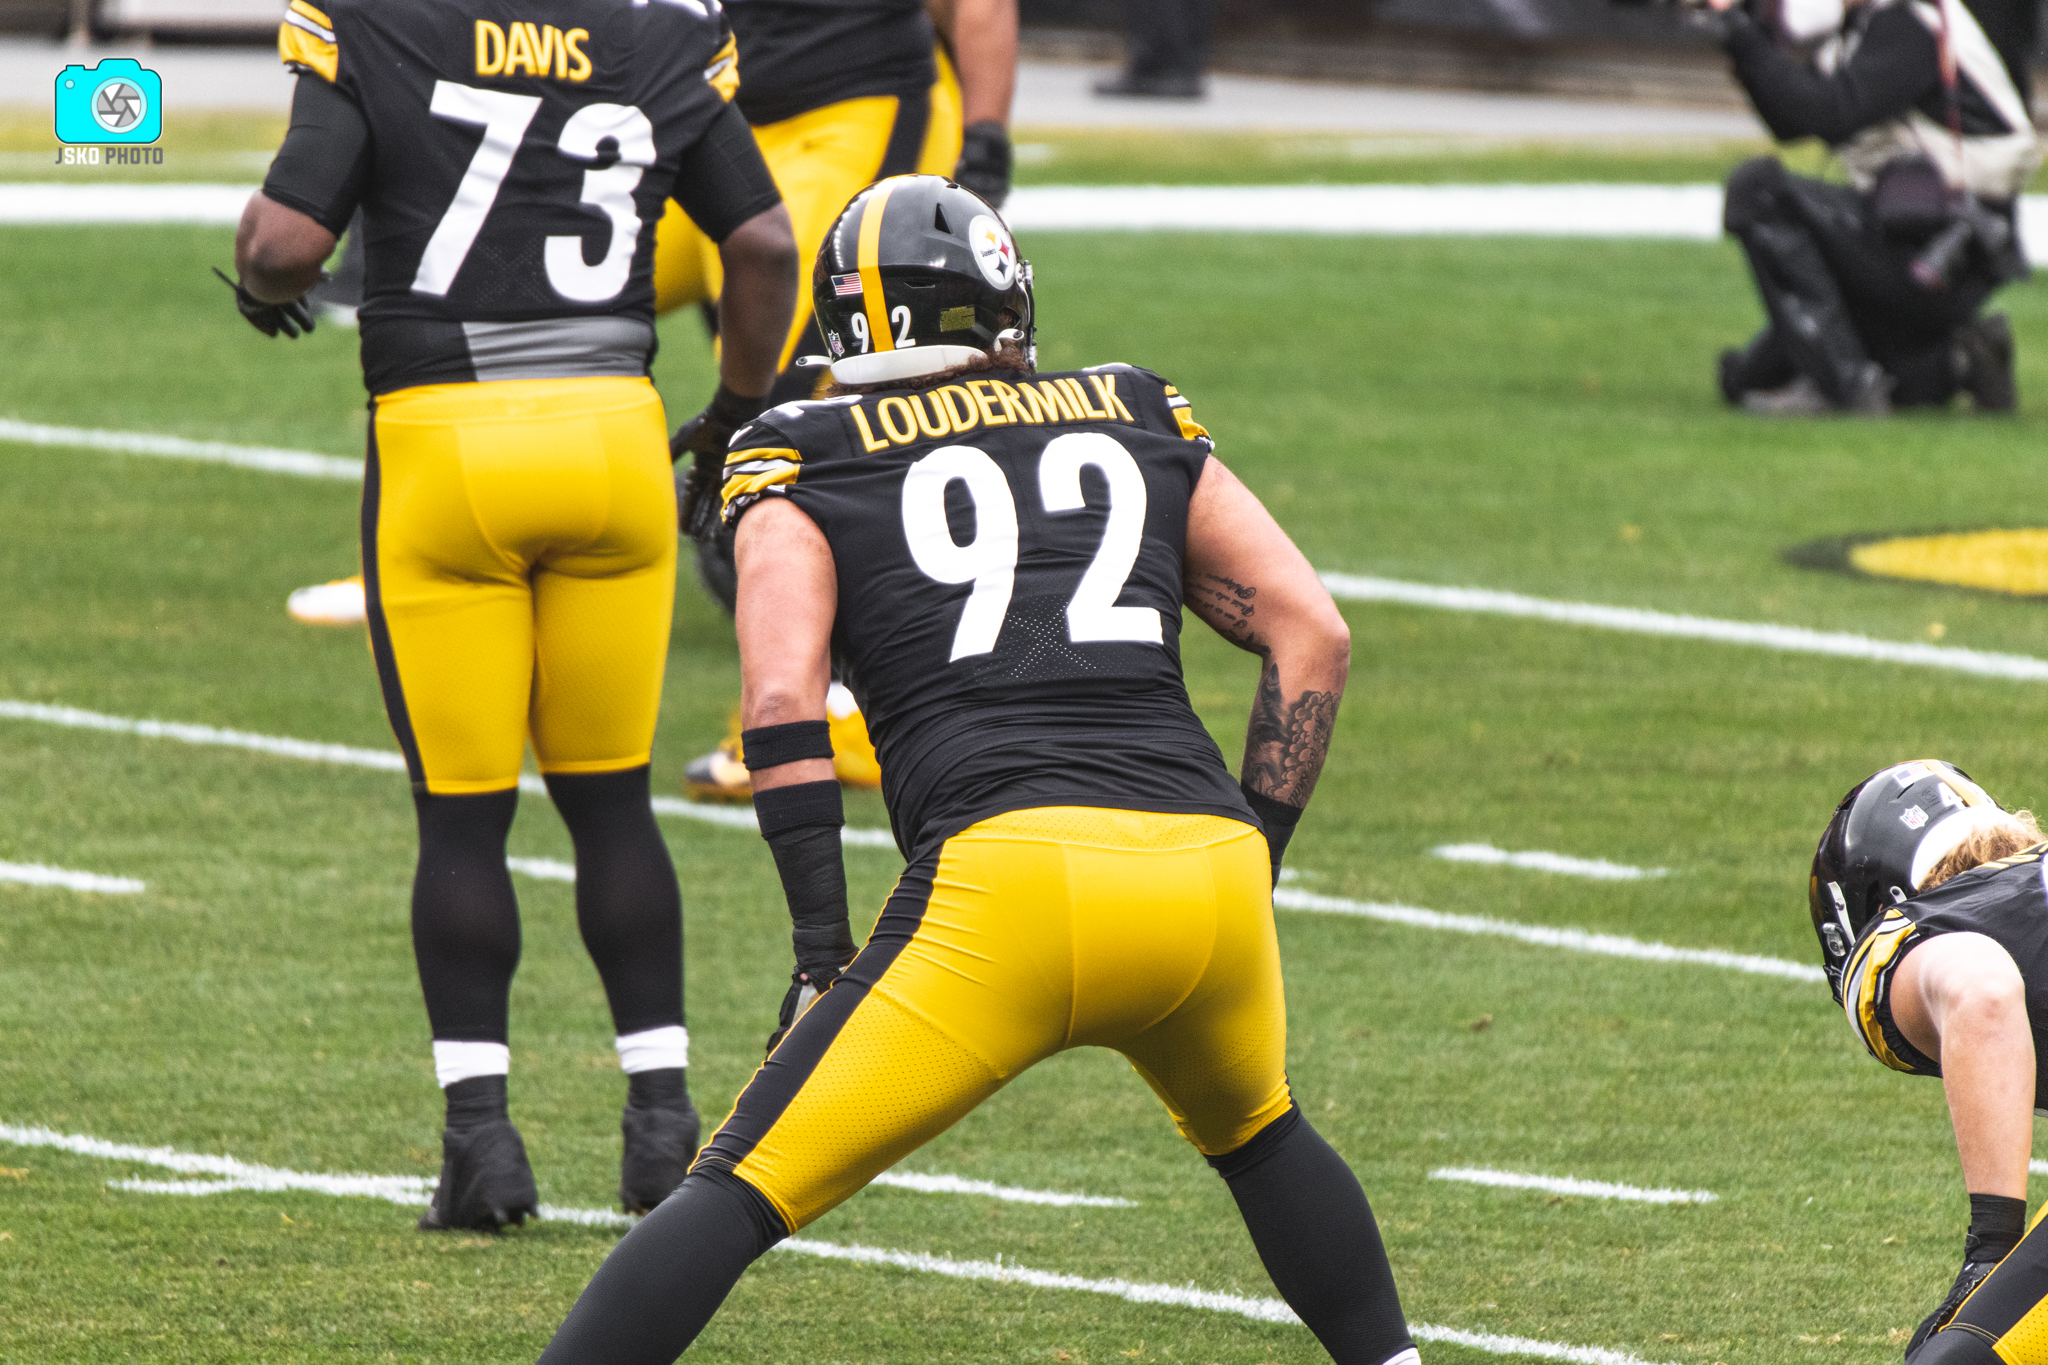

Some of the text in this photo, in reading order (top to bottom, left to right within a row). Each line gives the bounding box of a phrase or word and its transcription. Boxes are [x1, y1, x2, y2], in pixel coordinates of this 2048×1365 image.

[474, 20, 592, 82] DAVIS
[410, 80, 657, 302] 73
[850, 373, 1135, 453] LOUDERMILK
[902, 432, 1164, 662] 92
